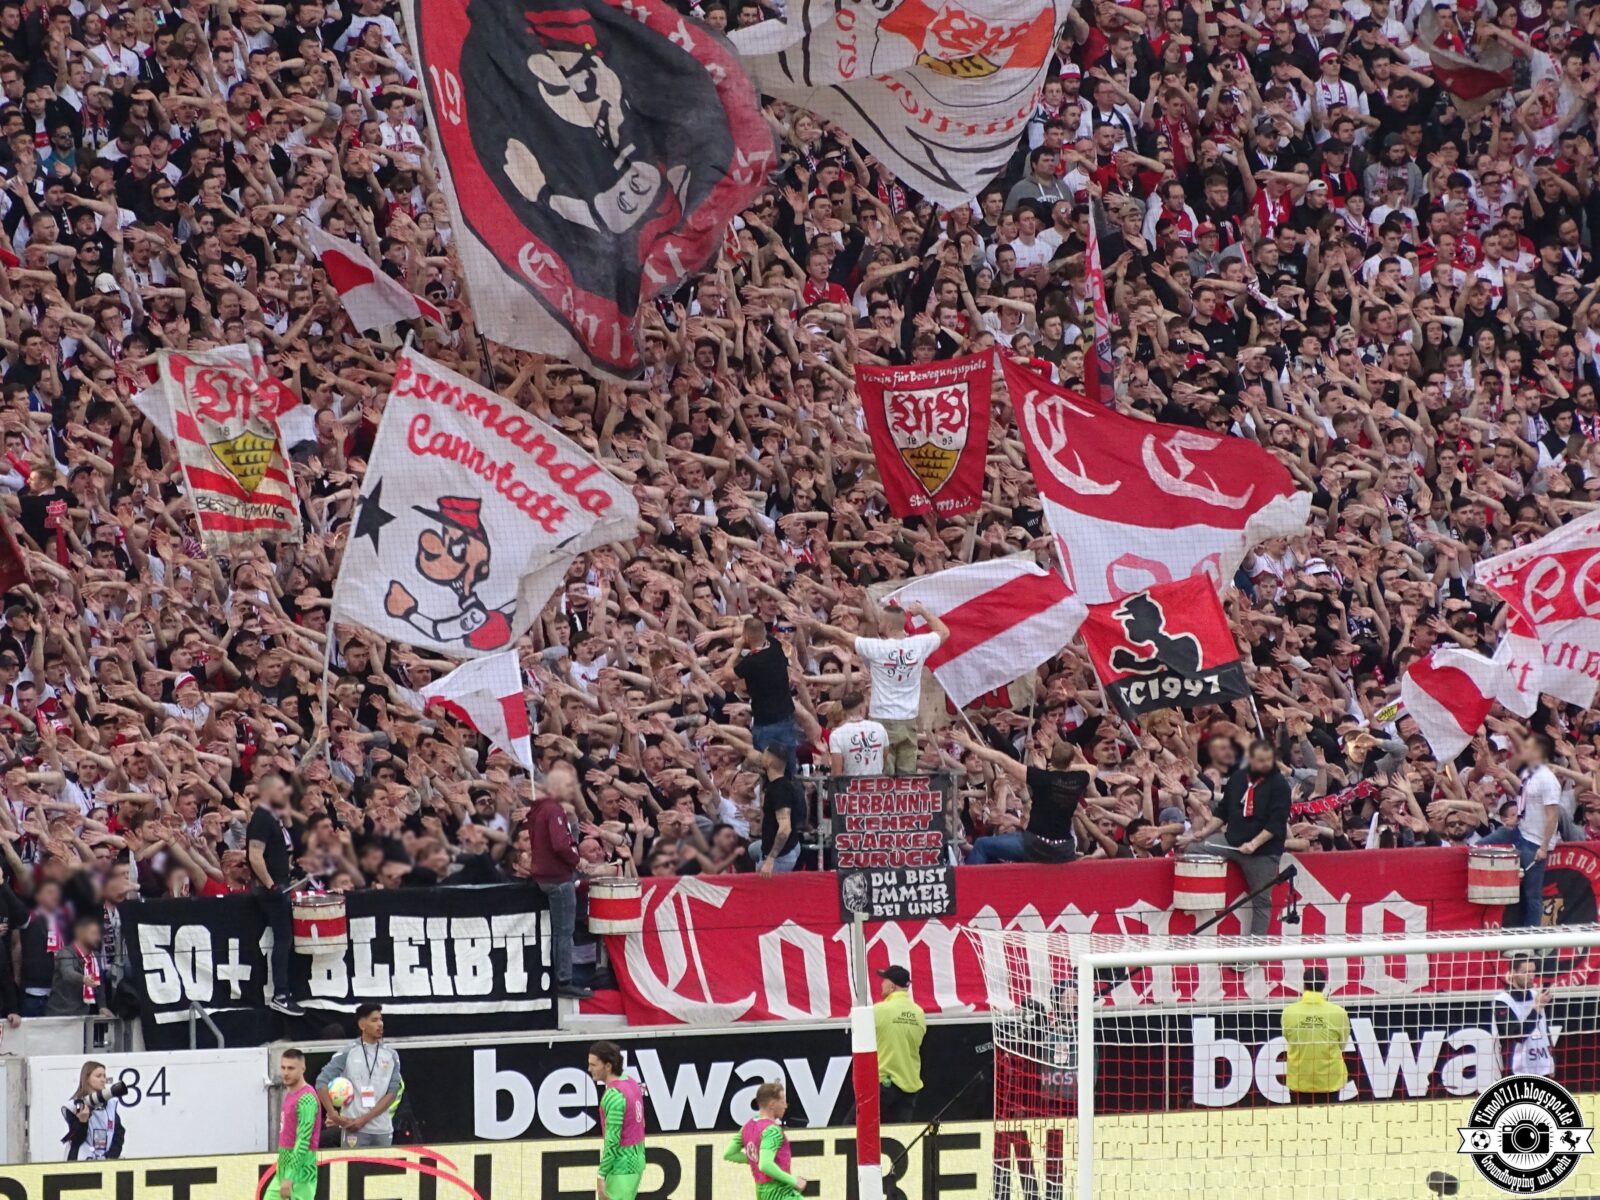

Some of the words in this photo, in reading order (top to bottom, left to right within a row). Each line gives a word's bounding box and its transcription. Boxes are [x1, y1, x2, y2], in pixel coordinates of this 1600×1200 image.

[407, 413, 571, 534] Cannstatt
[846, 777, 930, 793] JEDER
[834, 791, 942, 815] VERBANNTE
[845, 813, 933, 832] KEHRT
[871, 872, 897, 886] DU
[905, 868, 947, 884] BIST
[871, 883, 949, 904] IMMER
[873, 904, 900, 916] BEI
[907, 900, 951, 915] UNS!
[308, 909, 552, 998] BLEIBT!
[1193, 1018, 1562, 1108] bewa
